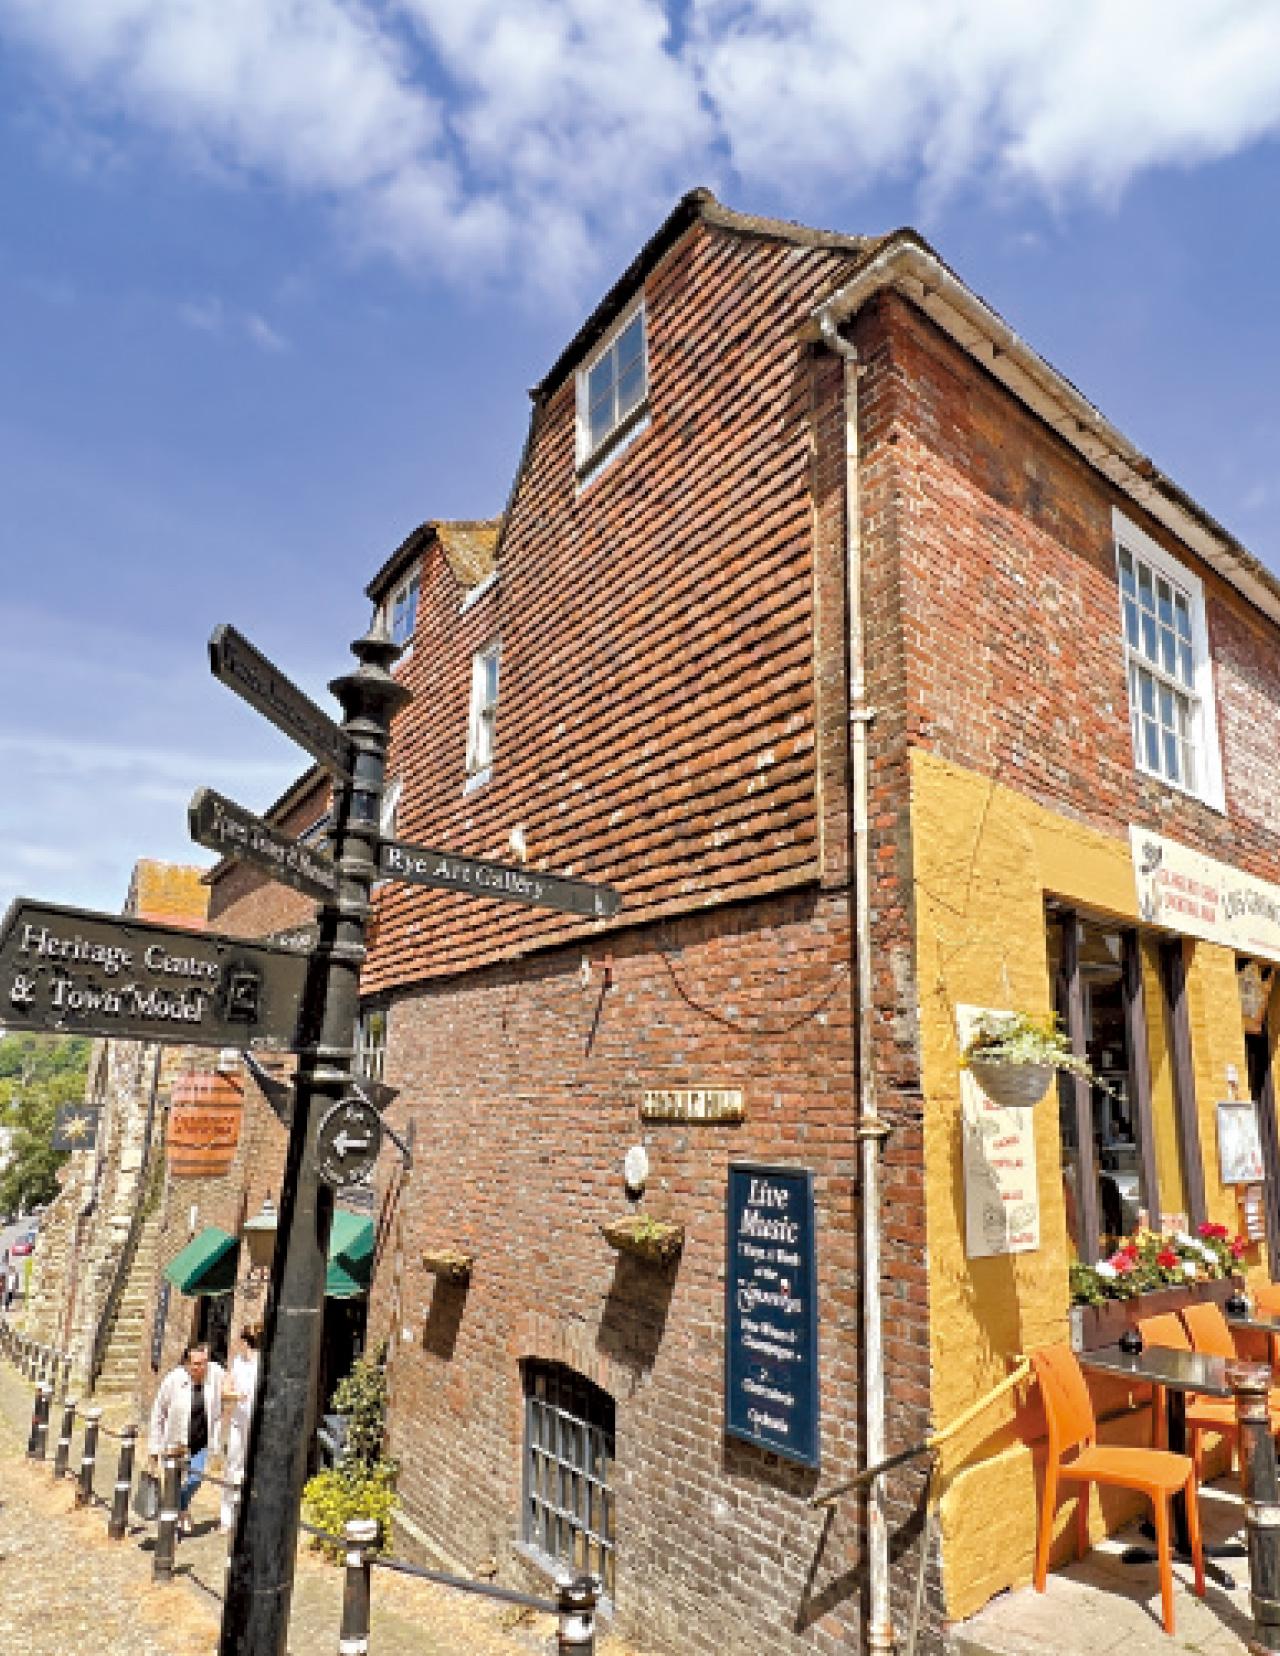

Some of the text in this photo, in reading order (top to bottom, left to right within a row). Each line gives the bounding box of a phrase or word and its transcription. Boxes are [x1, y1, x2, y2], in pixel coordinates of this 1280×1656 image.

[389, 848, 543, 899] Rye Art Gallery
[21, 924, 221, 977] Heritage Centre
[9, 973, 207, 1022] & Town Model
[748, 1179, 788, 1209] Live
[738, 1209, 798, 1243] Music
